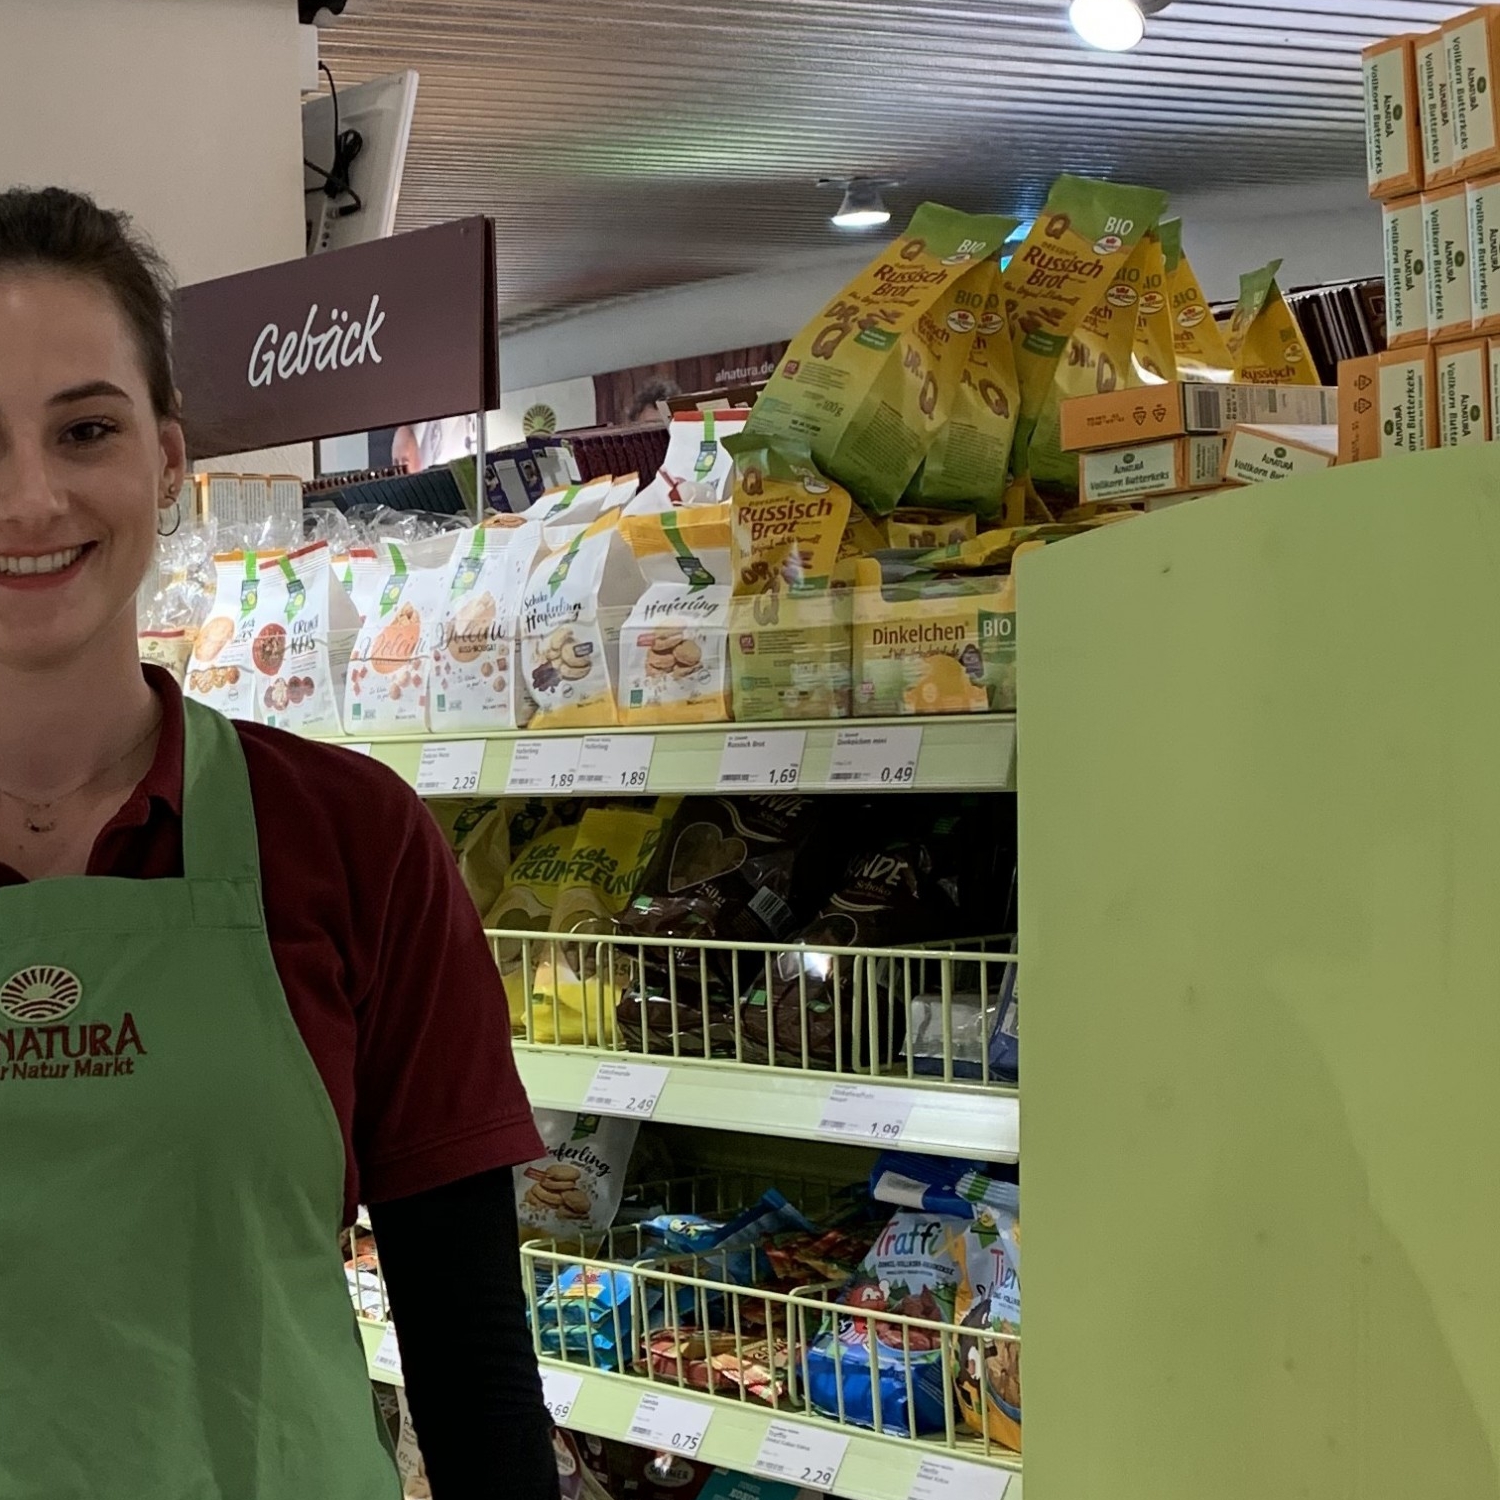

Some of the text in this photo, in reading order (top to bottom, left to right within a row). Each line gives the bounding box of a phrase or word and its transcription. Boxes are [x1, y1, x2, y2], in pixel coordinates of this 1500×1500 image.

[1452, 36, 1469, 150] Vollkorn Butterkeks
[1424, 52, 1440, 164] Vollkorn Butterkeks
[1370, 64, 1384, 175] Vollkorn Butterkeks
[1104, 216, 1134, 235] BIO
[957, 240, 987, 254] BIO
[1475, 197, 1488, 310] Vollkorn Butterkeks
[1022, 246, 1105, 279] Russisch
[1390, 218, 1403, 328] Vollkorn Butterkeks
[1430, 209, 1444, 320] Vollkorn Butterkeks
[874, 264, 948, 285] Russisch
[1027, 269, 1072, 290] Brot
[872, 283, 913, 297] Brot
[954, 290, 982, 308] BIO
[248, 294, 386, 387] Gebäck
[715, 361, 775, 383] alnatura.de
[1241, 365, 1296, 381] Russisch
[1447, 362, 1457, 411] Vollkorn
[1234, 459, 1269, 478] Vollkorn
[738, 497, 833, 526] Russisch
[751, 521, 799, 542] Brot
[644, 595, 719, 620] Haferling
[873, 622, 966, 646] Dinkelchen
[983, 618, 1012, 638] BIO
[452, 776, 477, 790] 2,29
[550, 774, 575, 788] 1,89
[620, 771, 646, 786] 1,89
[769, 768, 798, 785] 1,69
[881, 766, 913, 783] 0,49
[572, 846, 618, 873] Keks
[855, 879, 892, 897] Schoko
[12, 1061, 70, 1081] Natur
[73, 1056, 135, 1079] Markt
[626, 1097, 654, 1113] 2,49
[871, 1122, 900, 1138] 1,99
[671, 1432, 699, 1450] 0,75
[800, 1467, 833, 1486] 2,29
